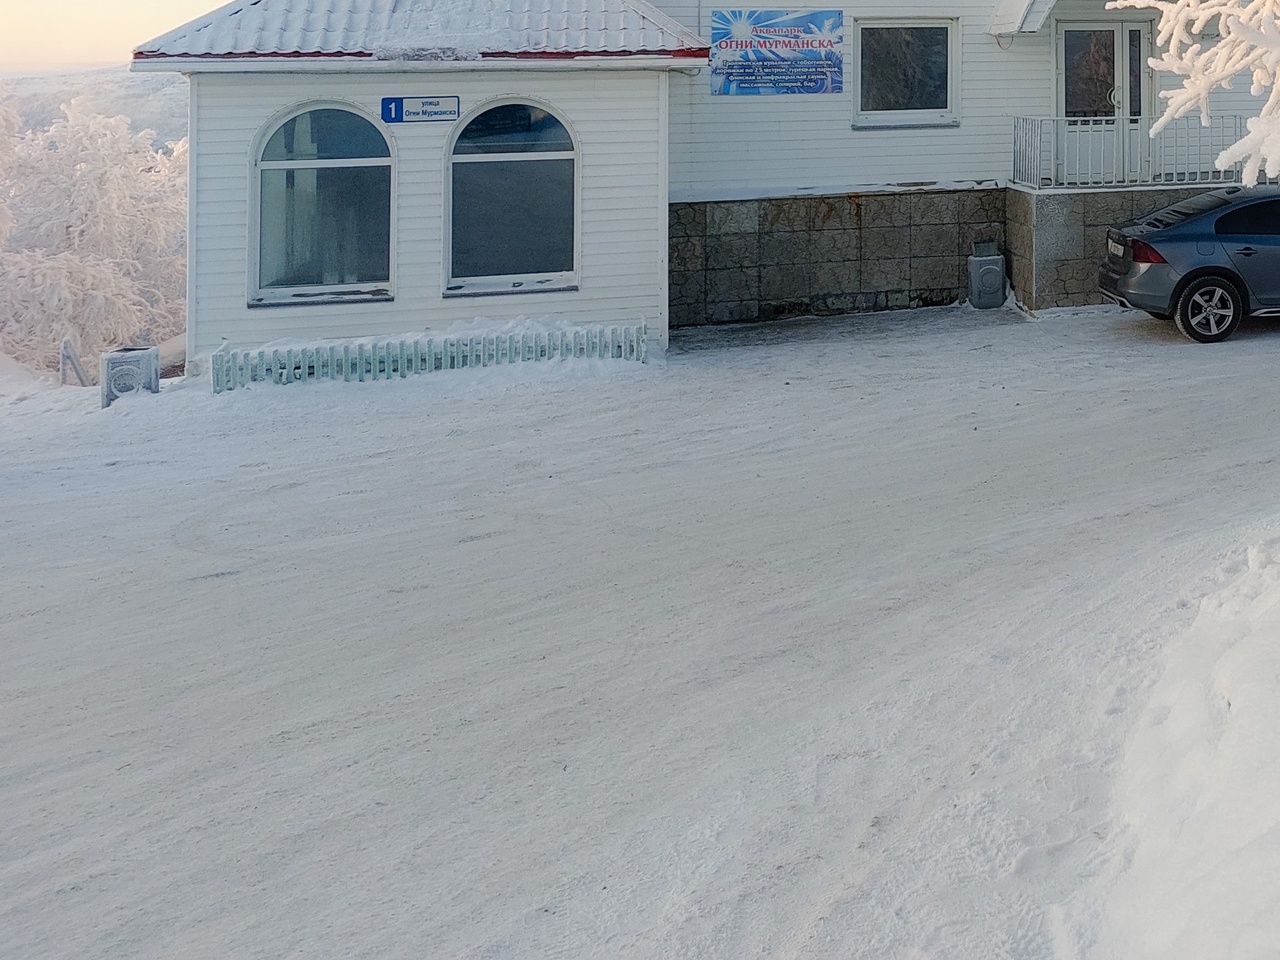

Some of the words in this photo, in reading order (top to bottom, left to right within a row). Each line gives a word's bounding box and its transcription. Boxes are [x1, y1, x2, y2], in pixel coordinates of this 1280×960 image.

[751, 26, 804, 37] Аквапарк
[718, 40, 753, 49] ОГНИ
[756, 39, 834, 49] МУРМАНСКА
[421, 100, 440, 108] улица
[388, 102, 396, 119] 1
[421, 109, 457, 117] Мурманска
